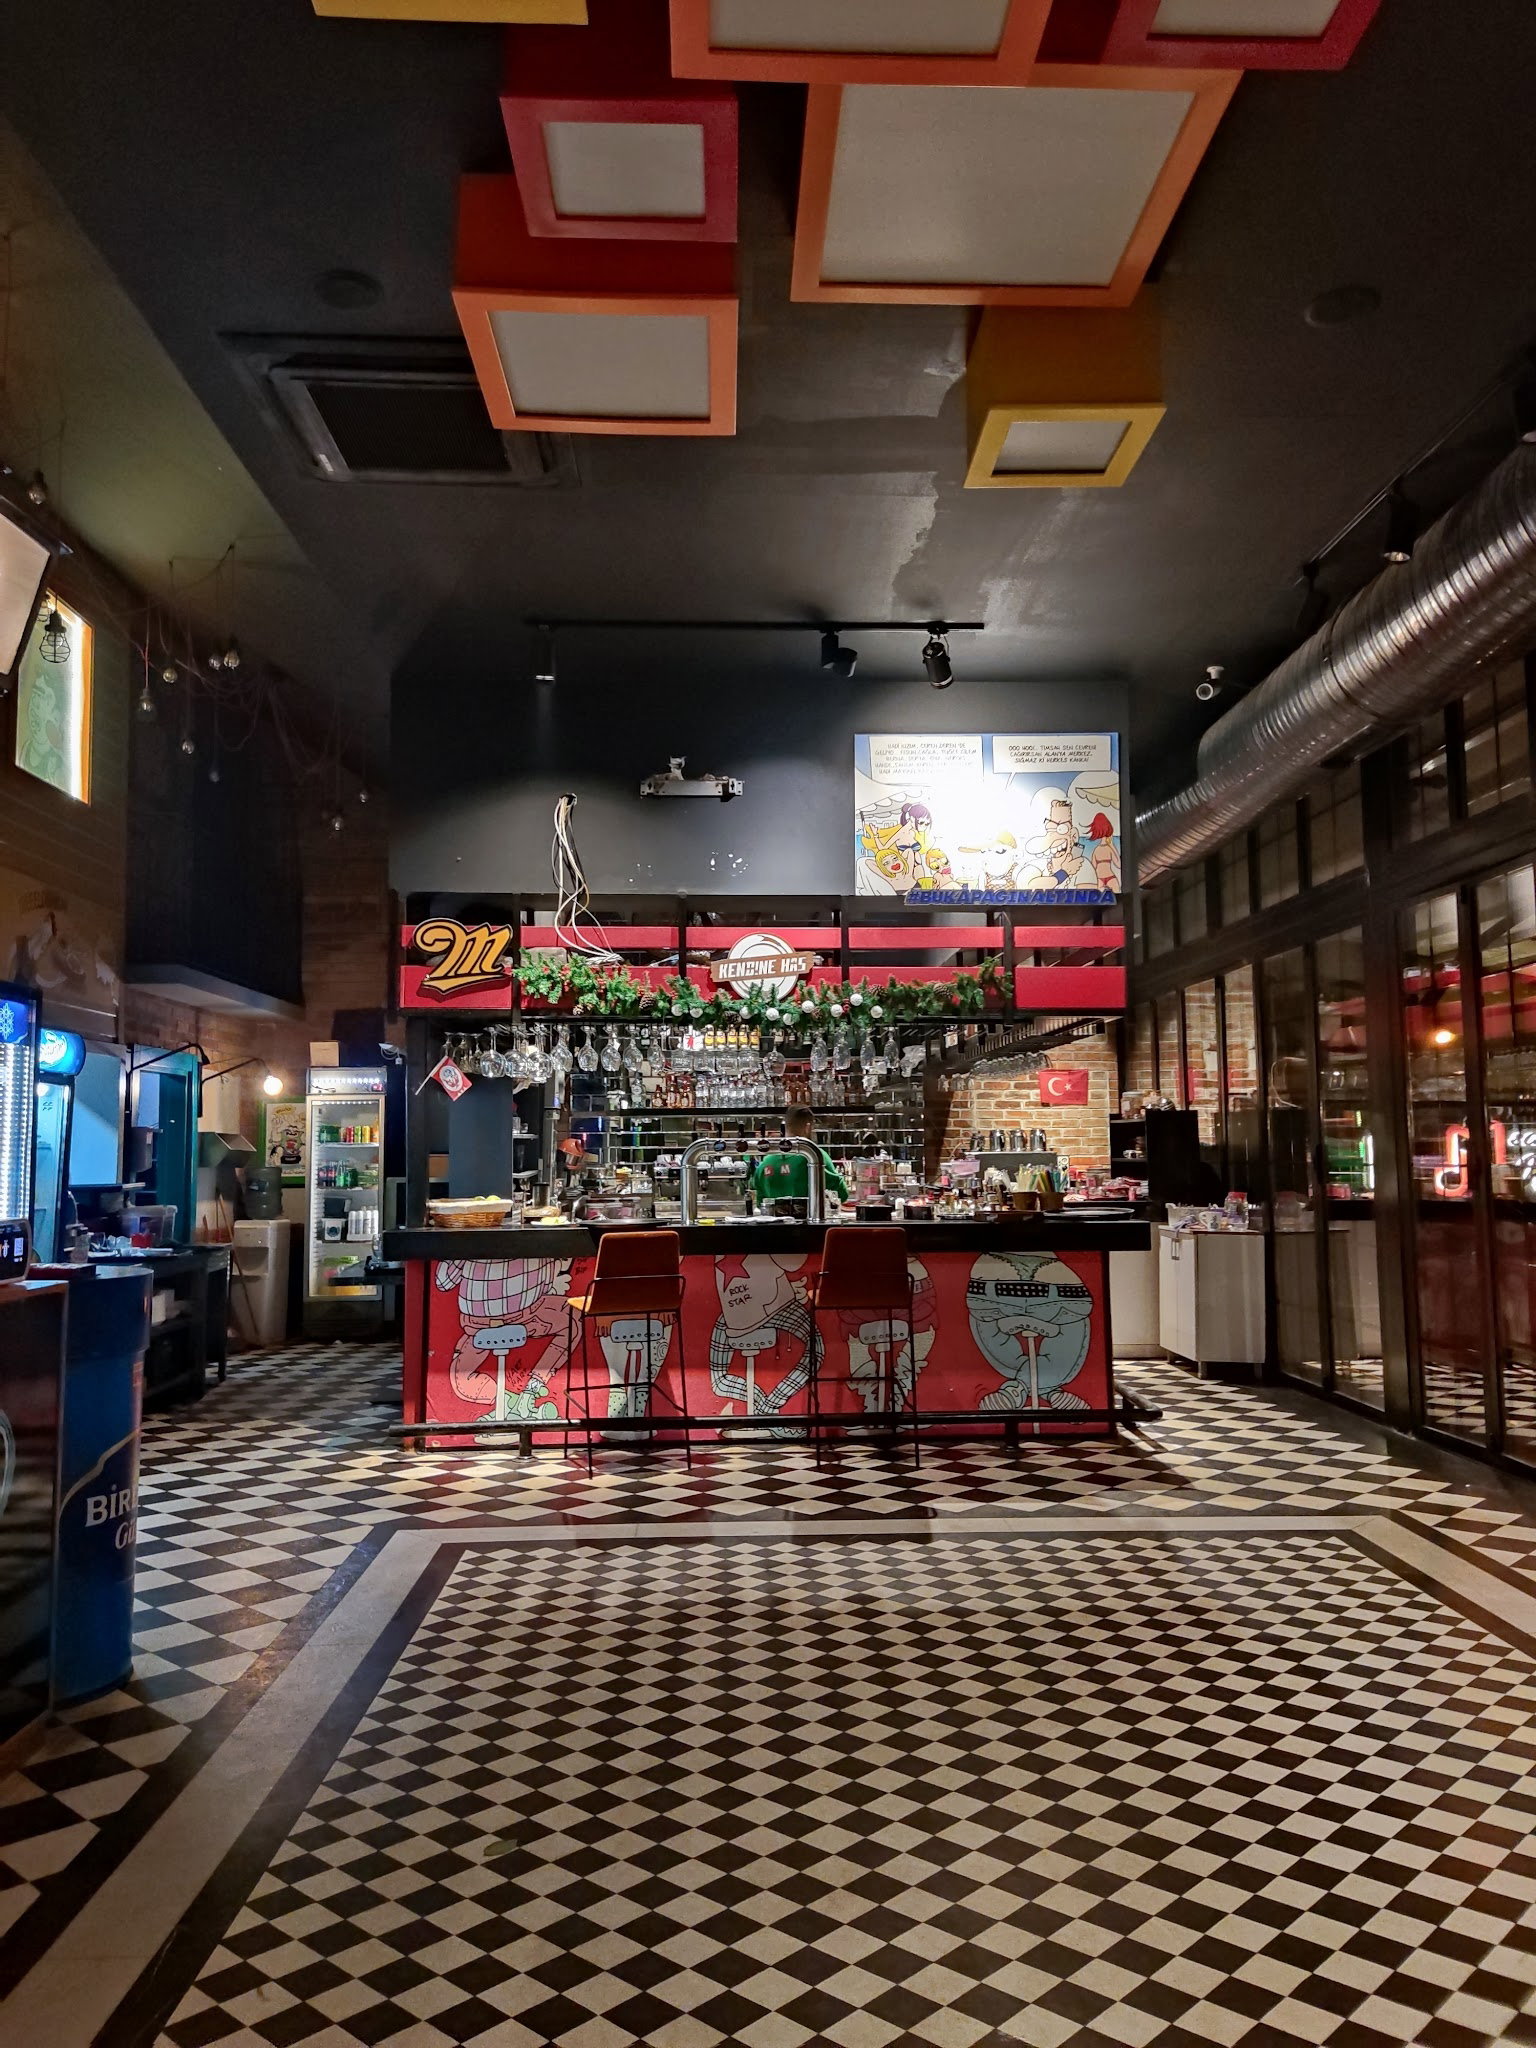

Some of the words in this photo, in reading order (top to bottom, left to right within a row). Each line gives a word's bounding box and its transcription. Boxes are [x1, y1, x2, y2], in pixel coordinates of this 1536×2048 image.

[780, 956, 807, 973] HAS
[728, 1283, 750, 1297] ROCK
[727, 1293, 753, 1308] STAR
